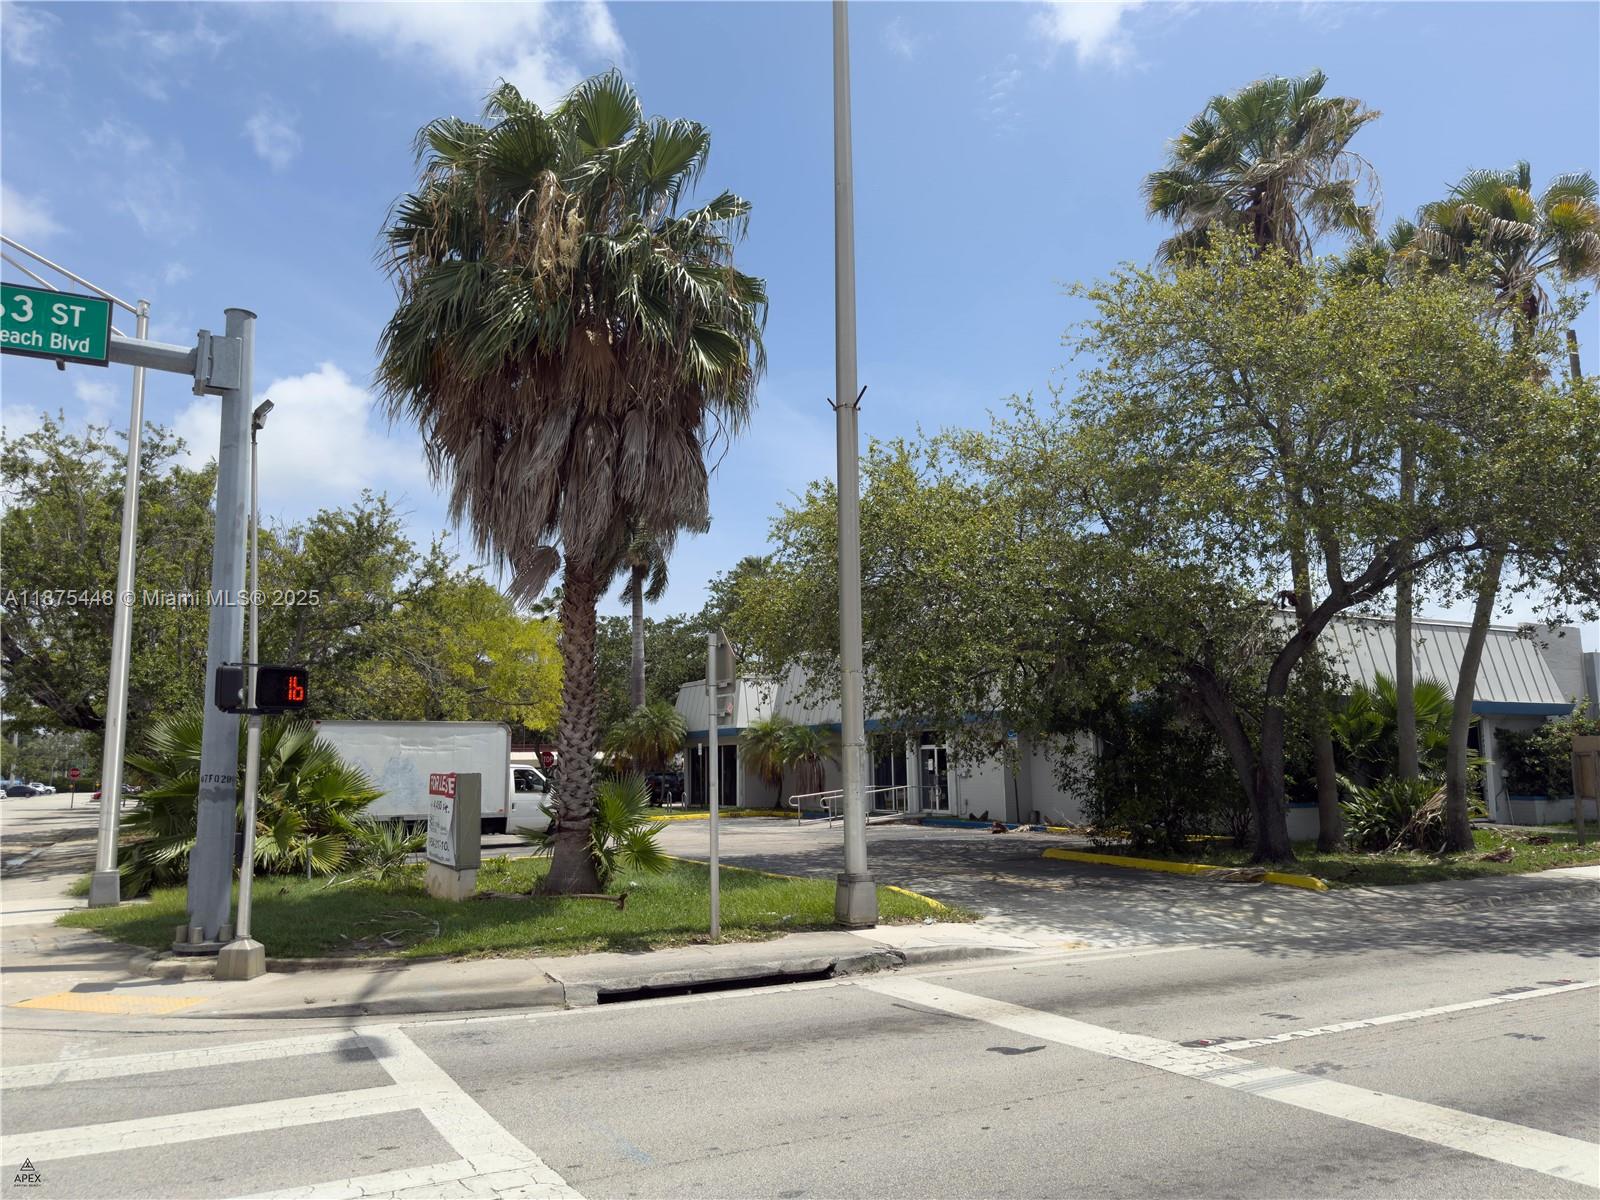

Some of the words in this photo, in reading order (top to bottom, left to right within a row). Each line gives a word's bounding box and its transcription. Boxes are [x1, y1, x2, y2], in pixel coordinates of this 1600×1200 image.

[0, 294, 34, 322] 3
[51, 303, 86, 327] ST
[50, 332, 90, 353] Blvd
[288, 675, 305, 701] 16
